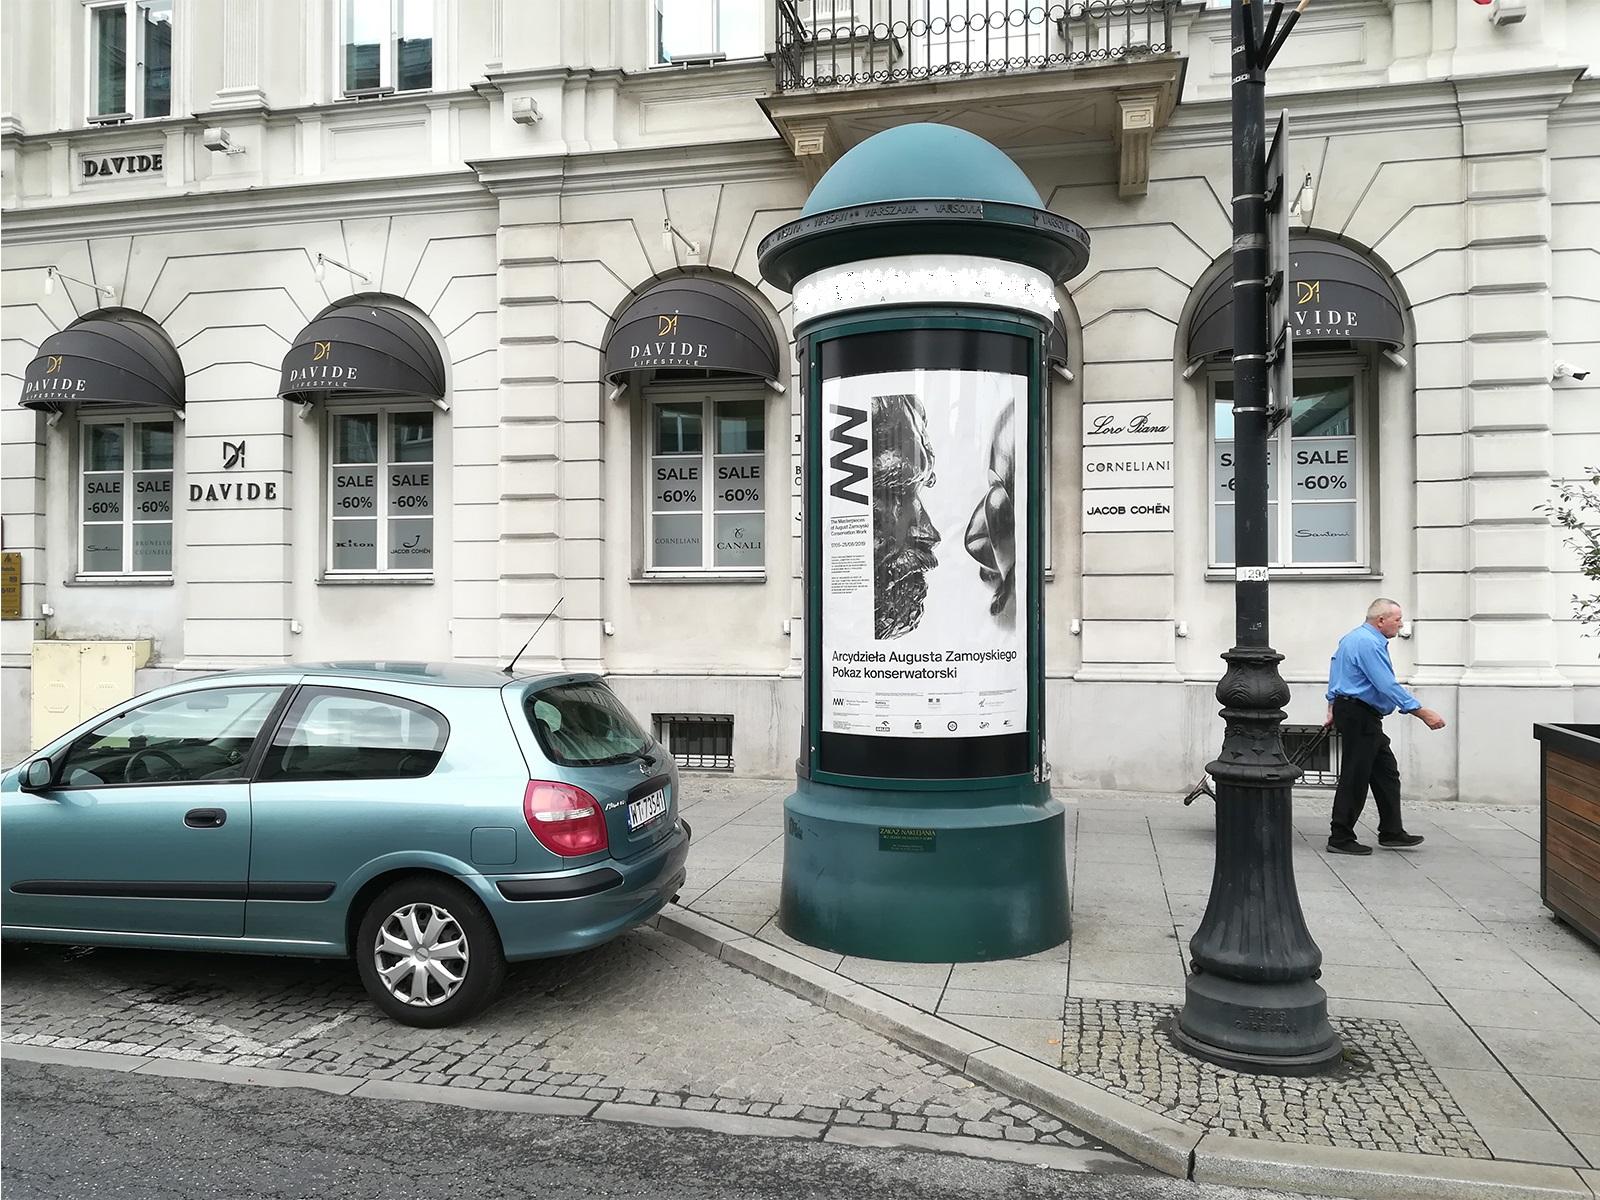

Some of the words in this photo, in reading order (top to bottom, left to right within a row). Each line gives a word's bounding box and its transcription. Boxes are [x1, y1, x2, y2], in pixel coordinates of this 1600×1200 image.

[83, 154, 162, 177] DAVIDE
[630, 341, 708, 359] DAVIDE
[634, 358, 699, 367] LIFESTYLE
[290, 365, 358, 382] DAVIDE
[26, 378, 86, 394] DAVIDE
[291, 380, 348, 390] LIFESTYLE
[1087, 415, 1126, 435] Loro
[1127, 412, 1170, 434] Piana
[1296, 450, 1349, 465] SALE
[718, 466, 760, 480] SALE
[1086, 460, 1170, 473] CORNELIANI
[657, 467, 699, 480] SALE
[137, 480, 171, 493] SALE
[337, 475, 374, 488] SALE
[392, 474, 429, 487] SALE
[1296, 475, 1348, 490] -60%
[88, 481, 121, 494] SALE
[189, 482, 277, 502] DAVIDE
[392, 495, 429, 508] -60%
[657, 489, 697, 502] -60%
[718, 488, 759, 502] -60%
[88, 501, 120, 514] -60%
[137, 500, 170, 513] -60%
[337, 496, 373, 509] -60%
[1087, 505, 1126, 516] JACOB
[335, 539, 375, 548] Kiton
[654, 537, 700, 545] CORNELIANI
[716, 541, 762, 550] CANALI
[831, 650, 886, 665] Arcydzieła
[888, 651, 942, 665] Augusta
[945, 649, 1017, 664] Zamoyskiego
[832, 666, 861, 679] Pokaz
[863, 667, 957, 679] konserwatorski
